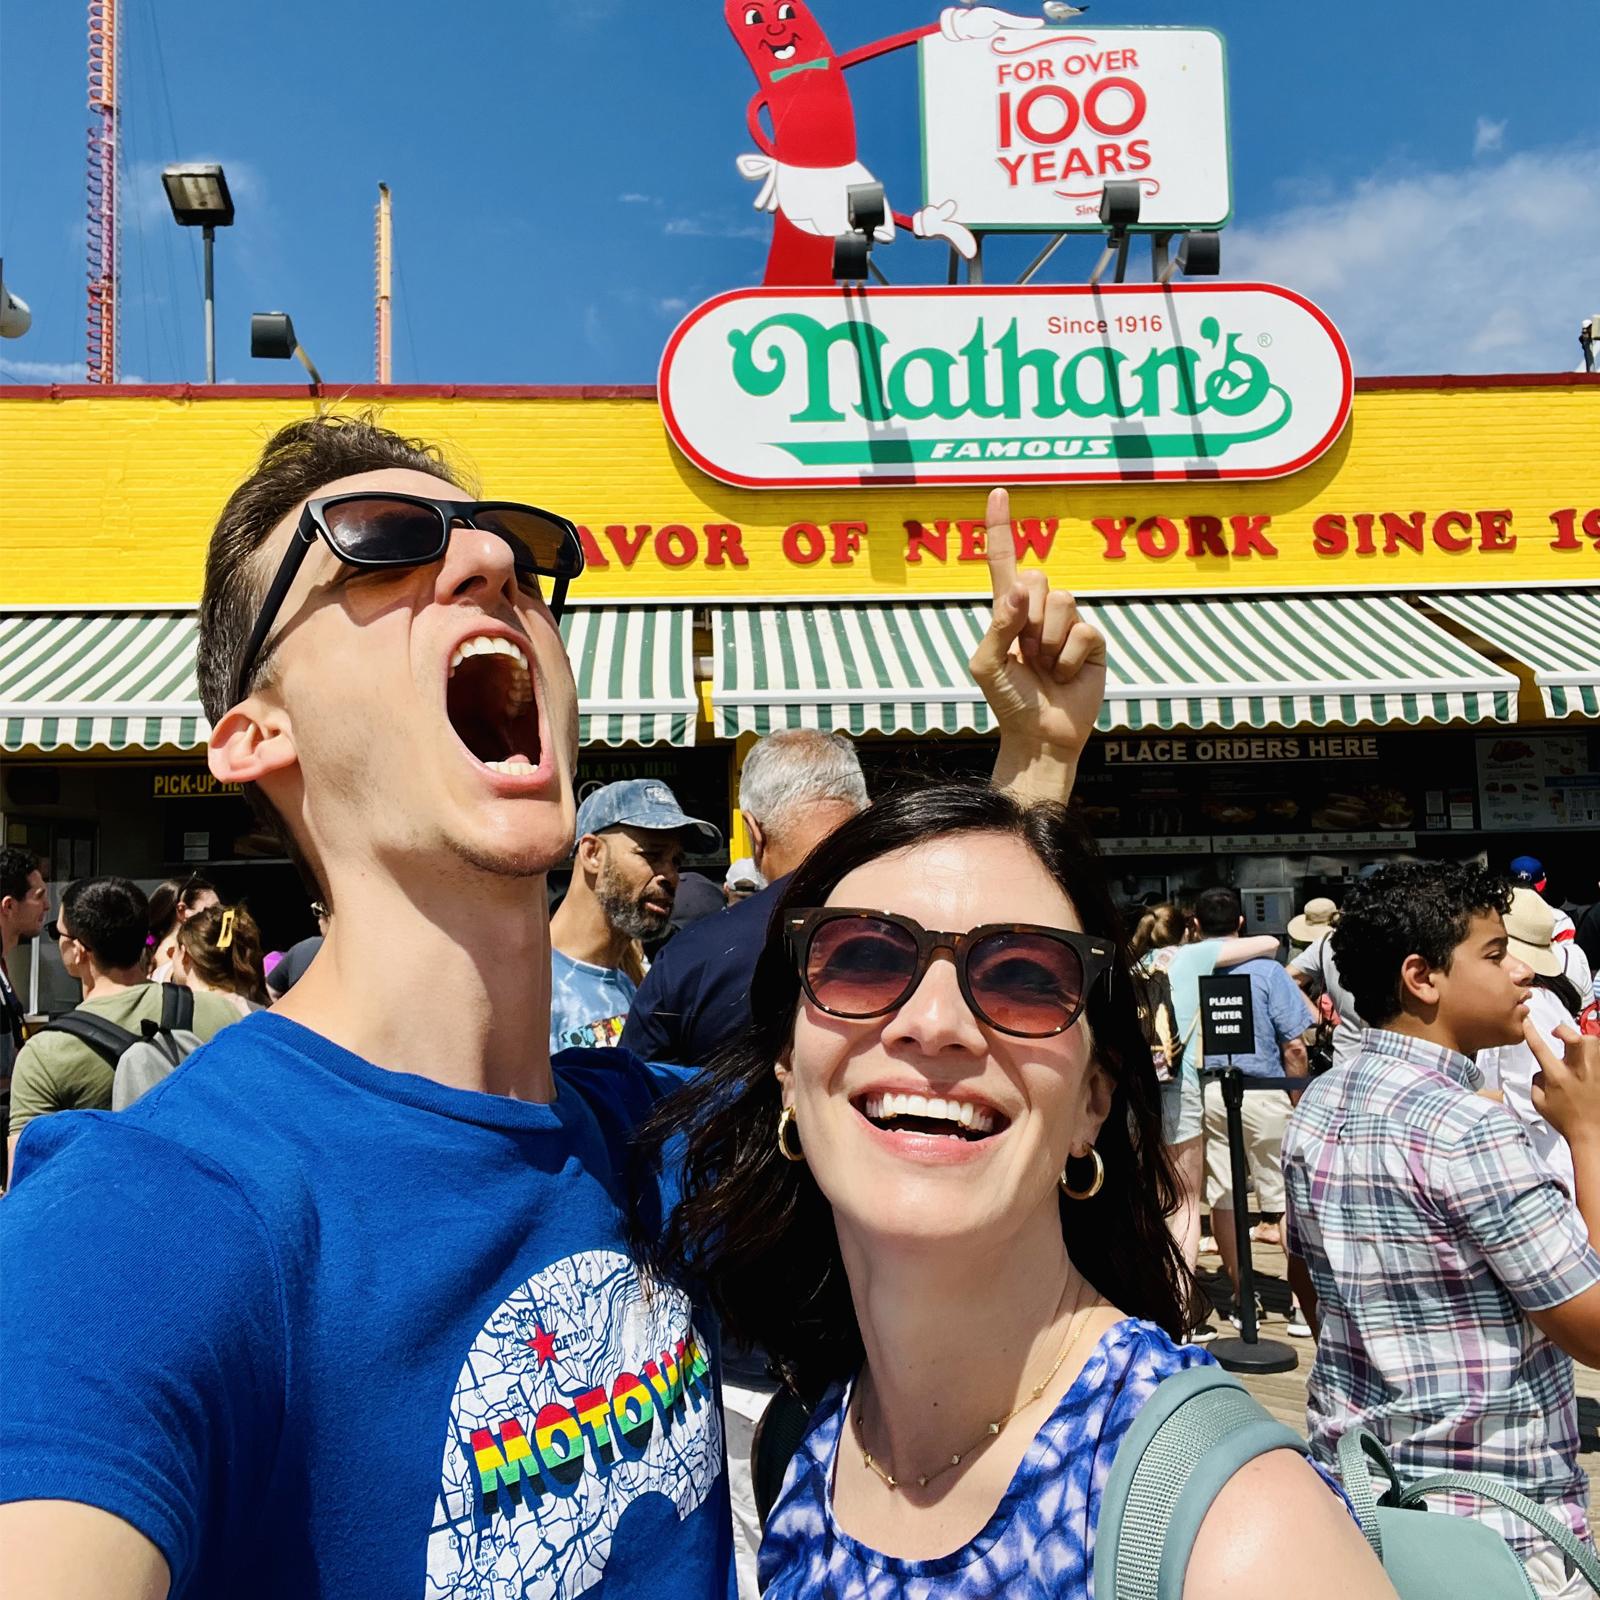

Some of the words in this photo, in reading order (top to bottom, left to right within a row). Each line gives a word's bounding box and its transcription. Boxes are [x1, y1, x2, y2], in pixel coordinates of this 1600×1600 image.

[997, 60, 1054, 84] FOR
[1063, 48, 1140, 77] OVER
[998, 77, 1147, 149] 100
[997, 140, 1152, 187] YEARS
[1075, 204, 1102, 216] Sinc
[1047, 316, 1108, 335] Since
[1114, 315, 1163, 333] 1916
[727, 312, 1270, 423] Nathan's
[930, 440, 1112, 459] FAMOUS
[782, 521, 868, 565] OF
[903, 518, 1060, 564] NEW
[1092, 515, 1278, 559] YORK
[1313, 509, 1518, 555] SINCE
[1104, 740, 1187, 762] PLACE
[1195, 738, 1300, 760] ORDERS
[1308, 736, 1379, 758] HERE
[153, 773, 217, 795] PICK-UP
[1209, 996, 1243, 1006] PLEASE
[1211, 1010, 1243, 1020] ENTER
[1215, 1025, 1240, 1034] HERE
[554, 1325, 594, 1351] DETROIT
[469, 1333, 711, 1517] MOTOWN
